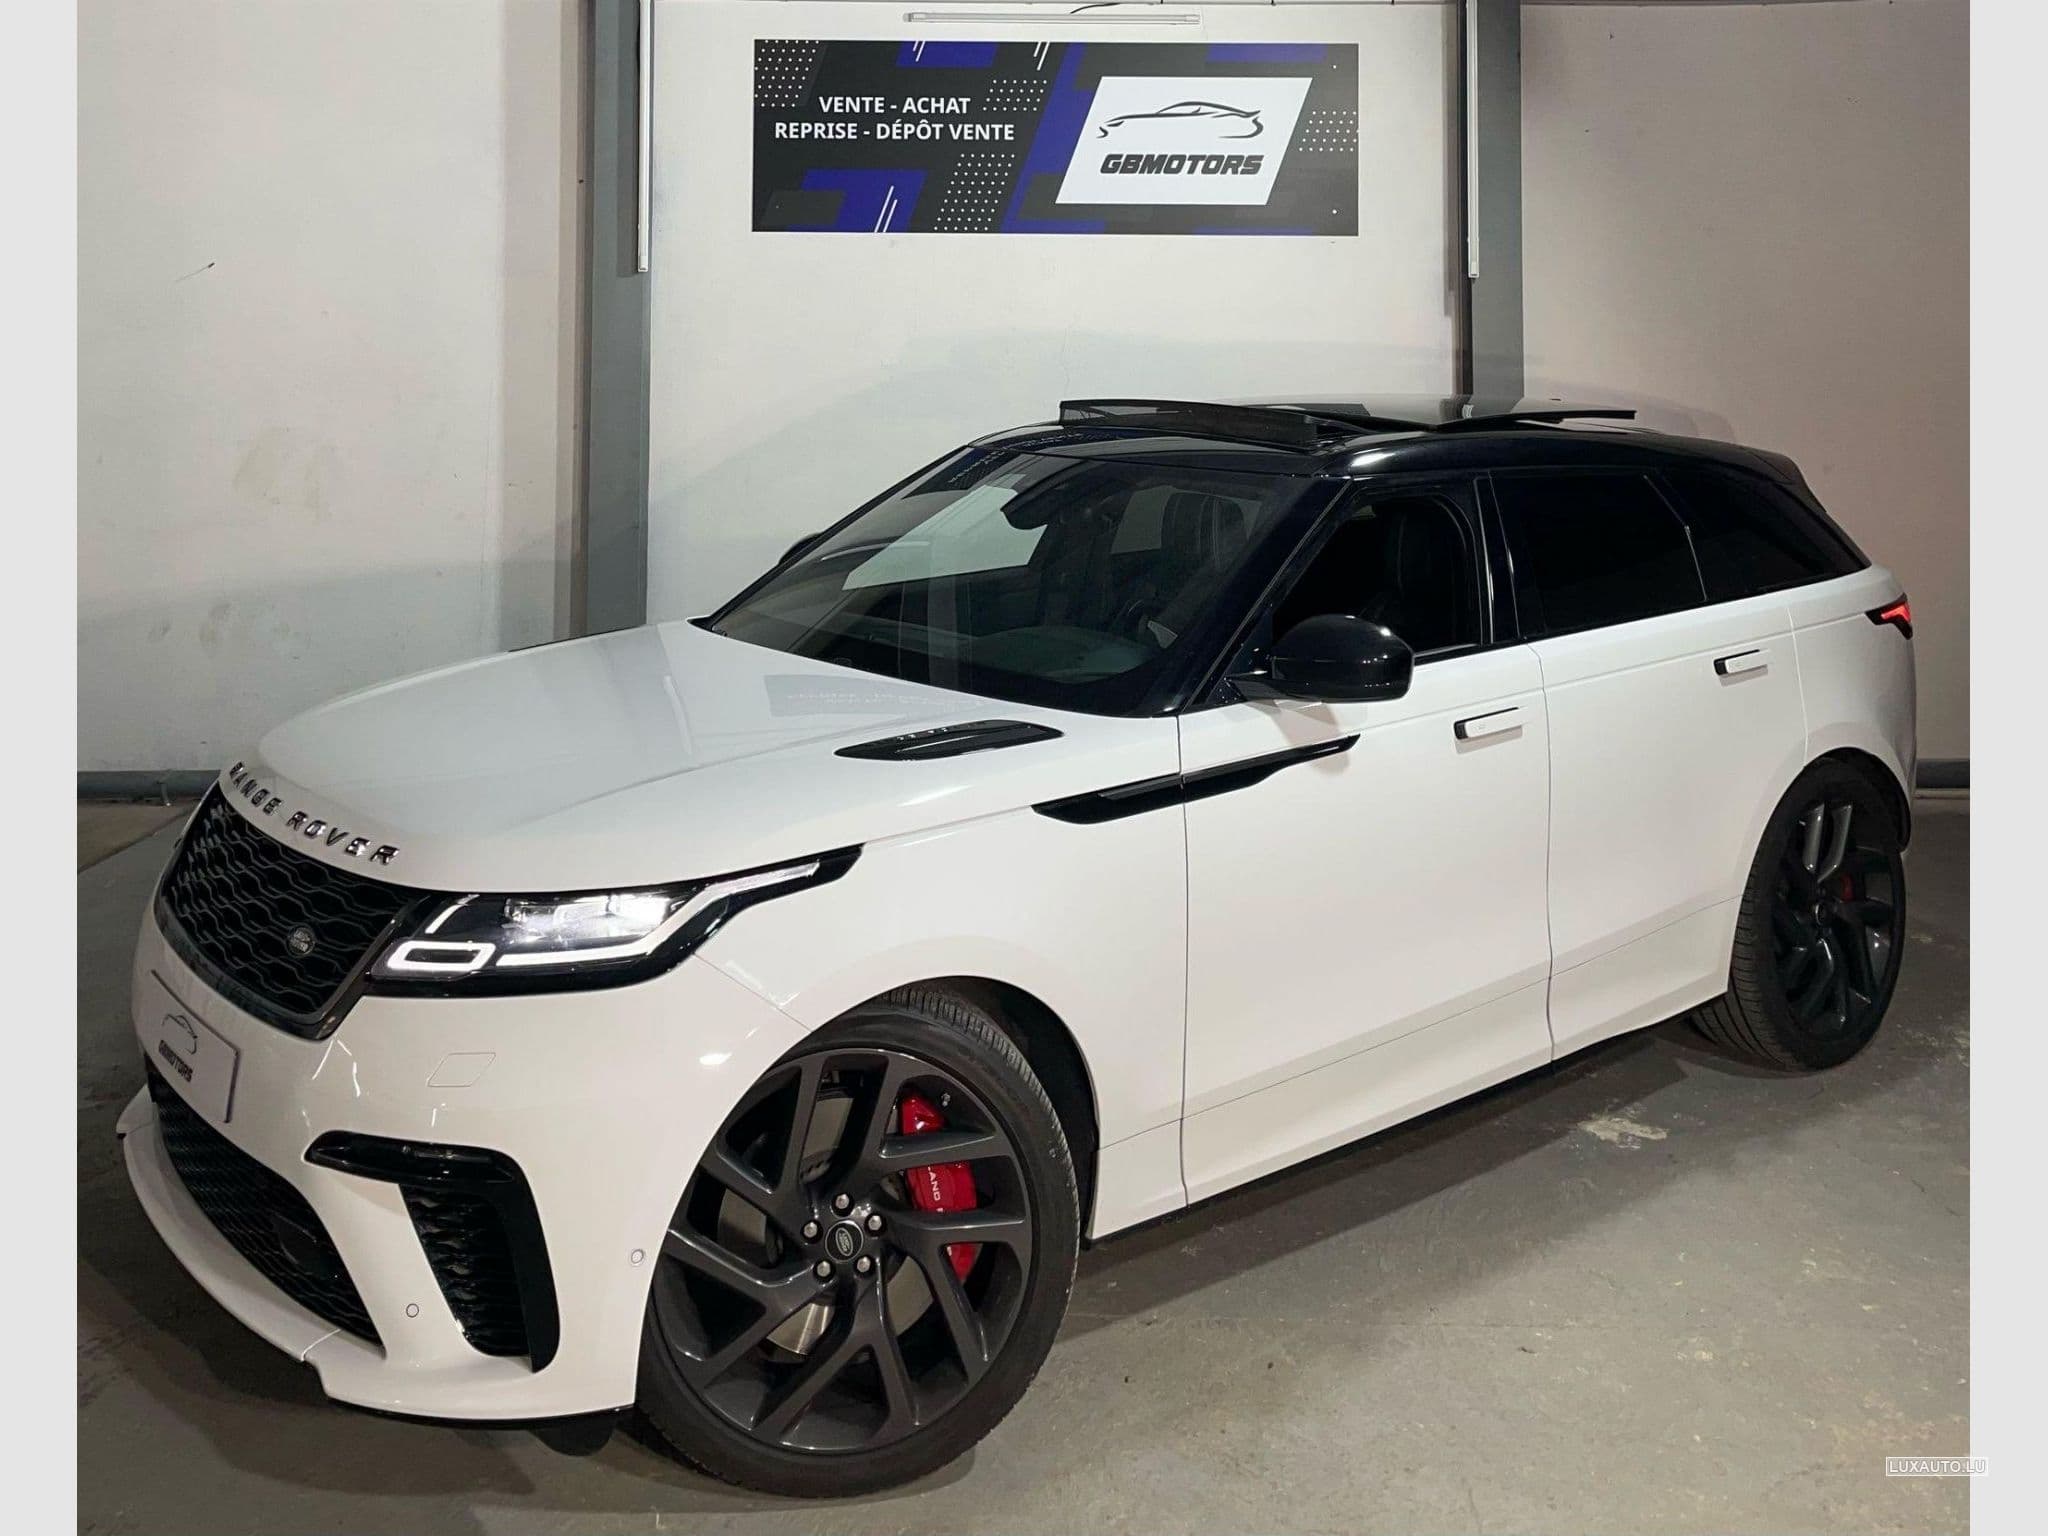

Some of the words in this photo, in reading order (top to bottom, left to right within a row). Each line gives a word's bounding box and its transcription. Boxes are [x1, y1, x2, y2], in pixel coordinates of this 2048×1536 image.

[818, 96, 885, 113] VENTE
[902, 97, 971, 114] ACHAT
[774, 122, 858, 139] REPRISE
[876, 119, 943, 140] DÉPÔT
[949, 124, 1015, 141] VENTE
[1099, 153, 1264, 175] GBMOTORS
[229, 761, 282, 816] RANGE
[286, 811, 400, 865] ROVER
